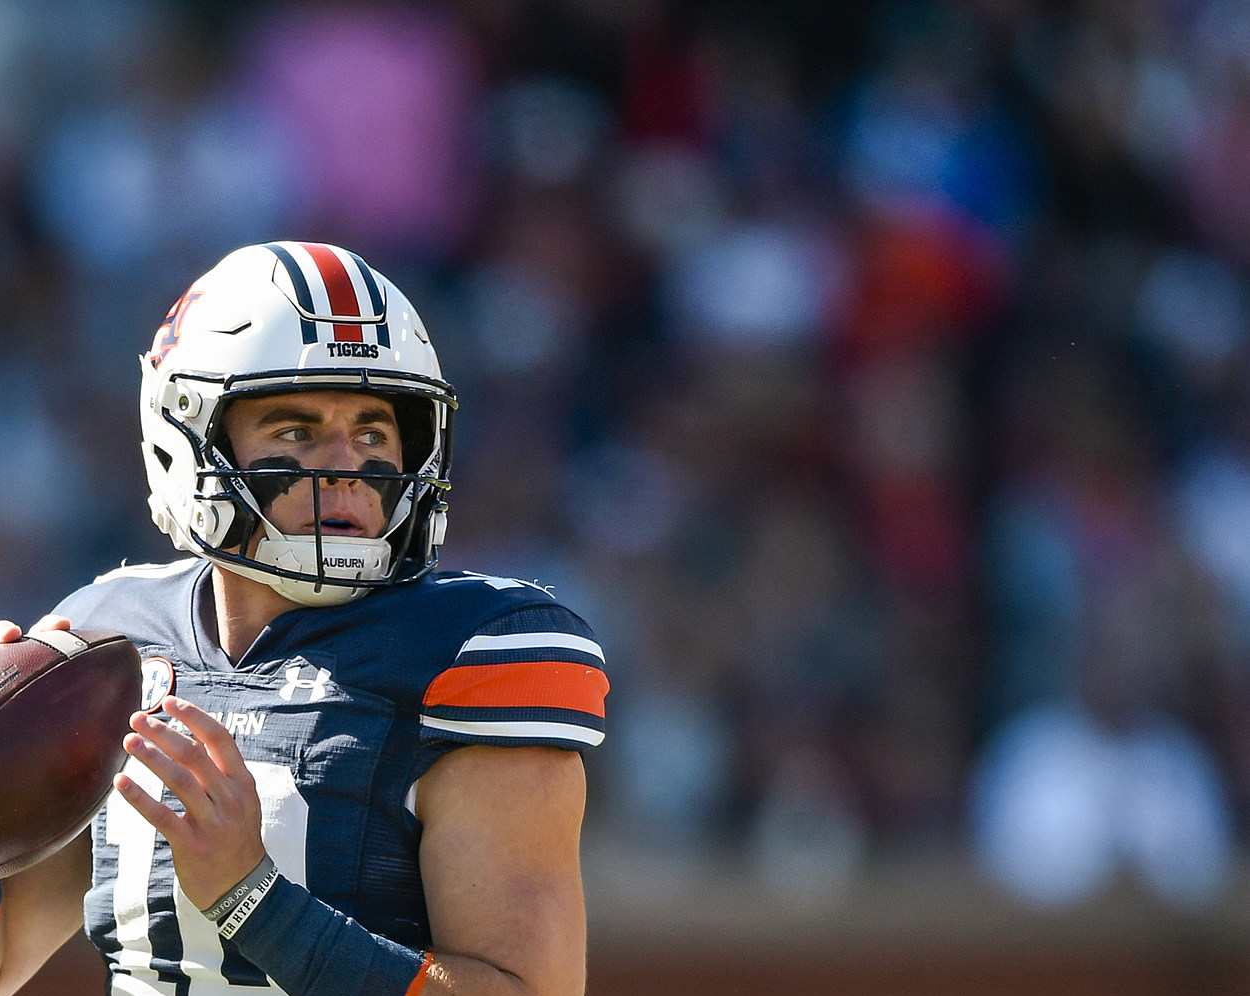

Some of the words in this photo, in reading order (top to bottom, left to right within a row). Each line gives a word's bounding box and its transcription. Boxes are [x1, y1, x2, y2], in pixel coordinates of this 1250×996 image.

[326, 342, 380, 360] TIGERS
[322, 557, 365, 569] AUBURN
[220, 896, 236, 911] FOR
[234, 884, 249, 900] JON
[232, 895, 258, 924] HYPE
